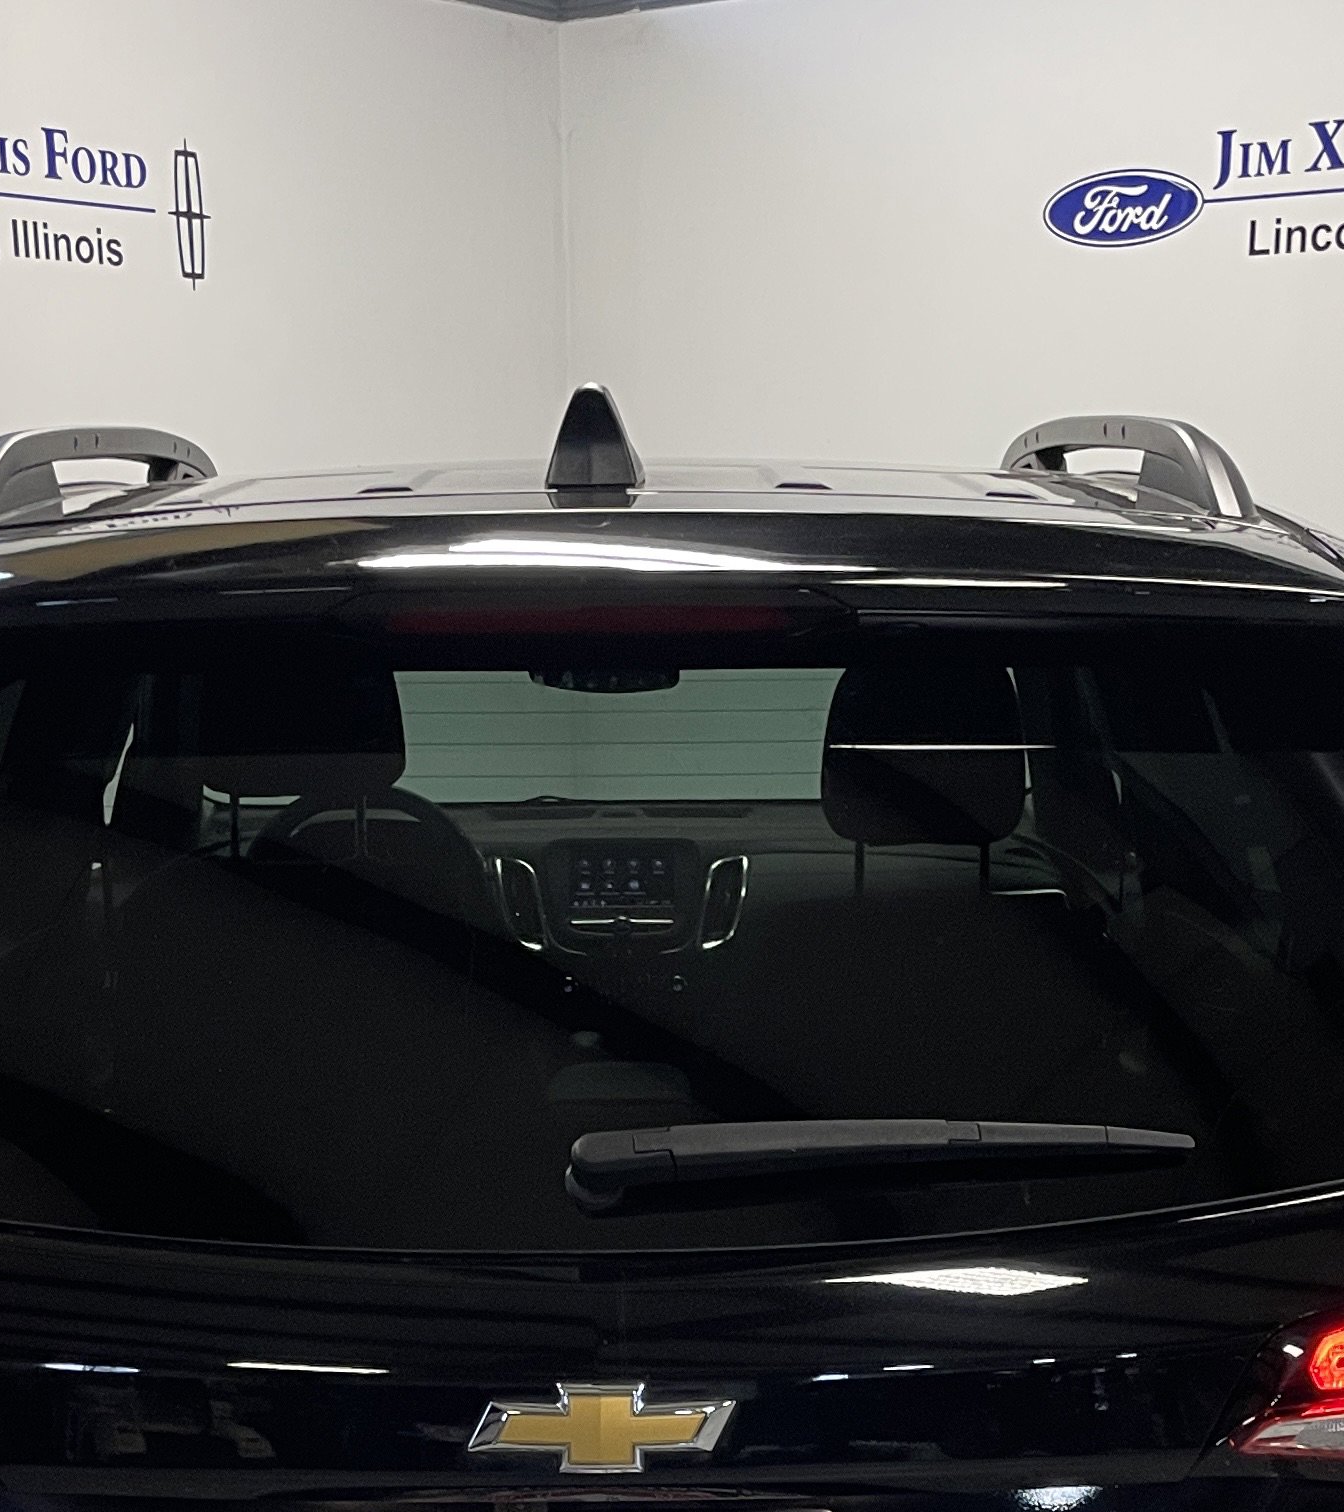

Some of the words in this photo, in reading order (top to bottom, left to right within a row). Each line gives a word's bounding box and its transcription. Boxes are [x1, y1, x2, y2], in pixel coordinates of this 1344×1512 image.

[40, 126, 147, 189] FORD
[1212, 129, 1292, 191] JIM
[1072, 184, 1171, 235] Ford
[11, 218, 124, 267] Illinois
